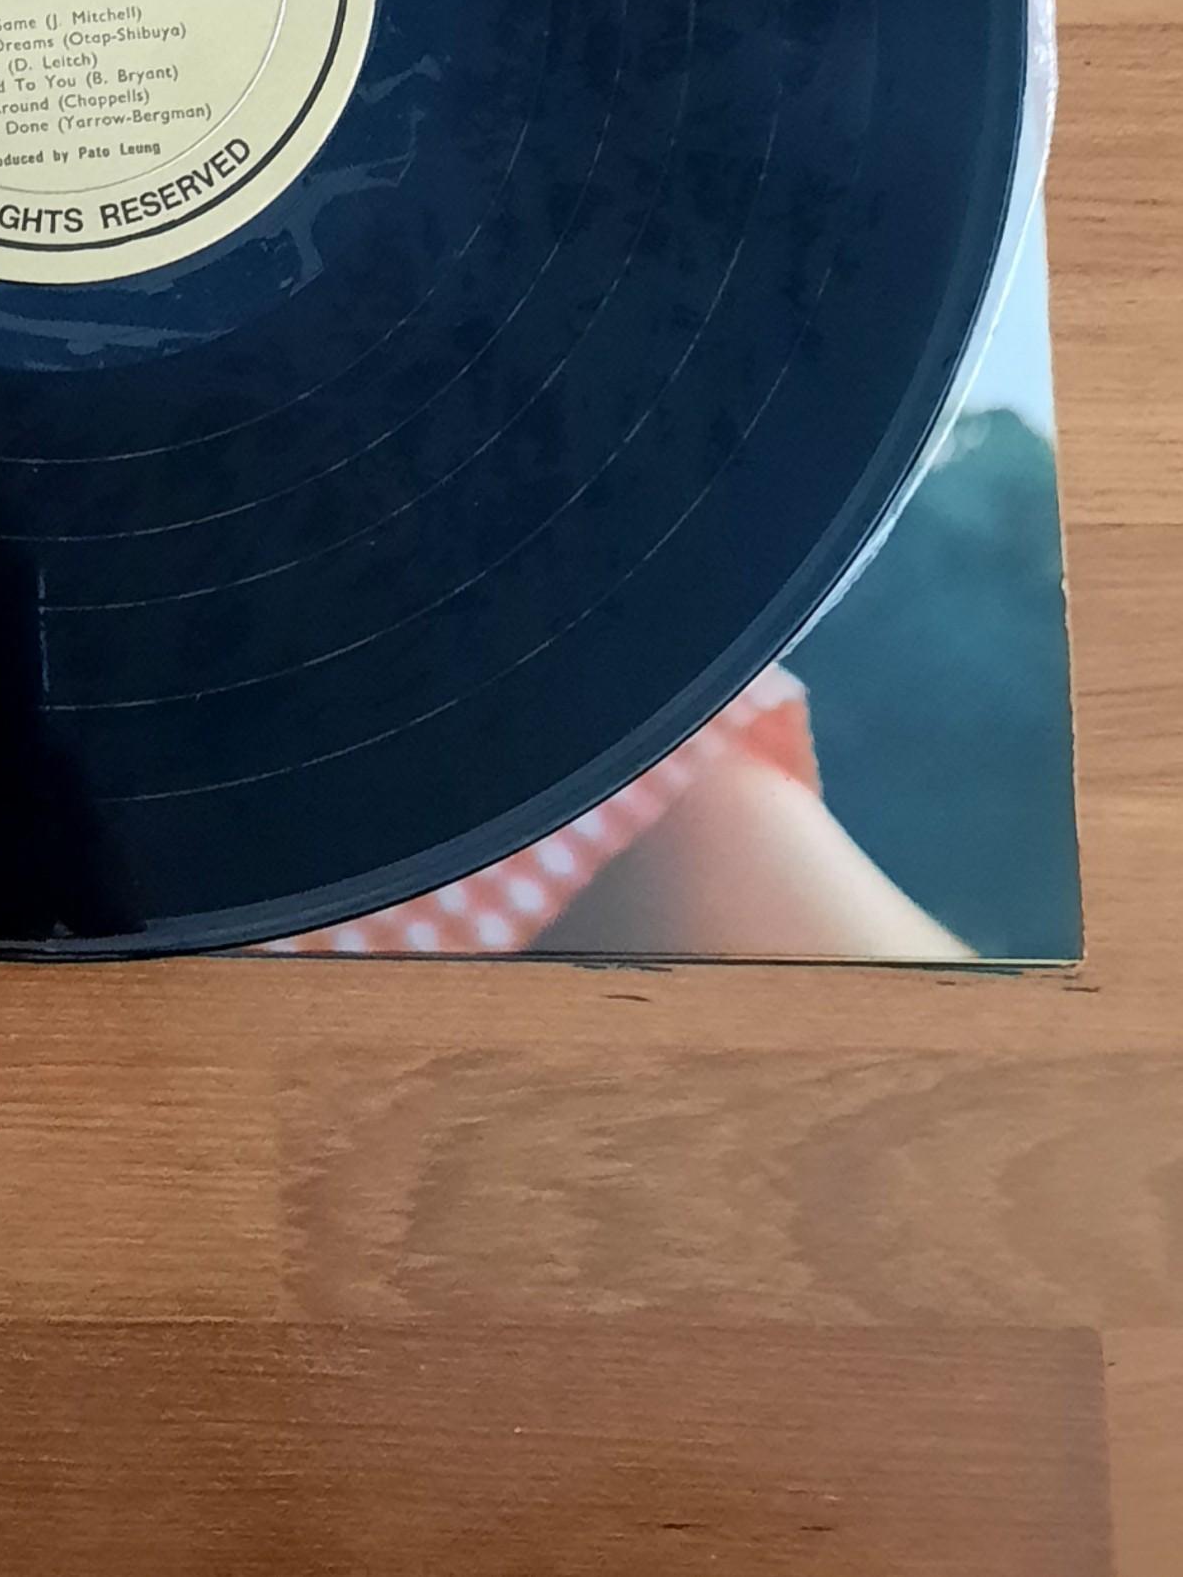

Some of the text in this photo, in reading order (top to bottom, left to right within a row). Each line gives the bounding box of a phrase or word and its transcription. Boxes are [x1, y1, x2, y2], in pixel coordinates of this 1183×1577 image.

[72, 6, 142, 25] Mitchell)
[8, 58, 32, 76] (D.
[14, 78, 36, 92] To
[44, 75, 77, 89] You
[86, 71, 108, 89] (B.
[118, 65, 179, 85] Bryant)
[5, 120, 50, 135] Done
[58, 103, 212, 134] (Yarrow-Bergman)
[53, 149, 69, 164] by
[78, 146, 111, 159] Pato
[120, 142, 161, 156] Leung
[99, 137, 251, 230] RESERVED
